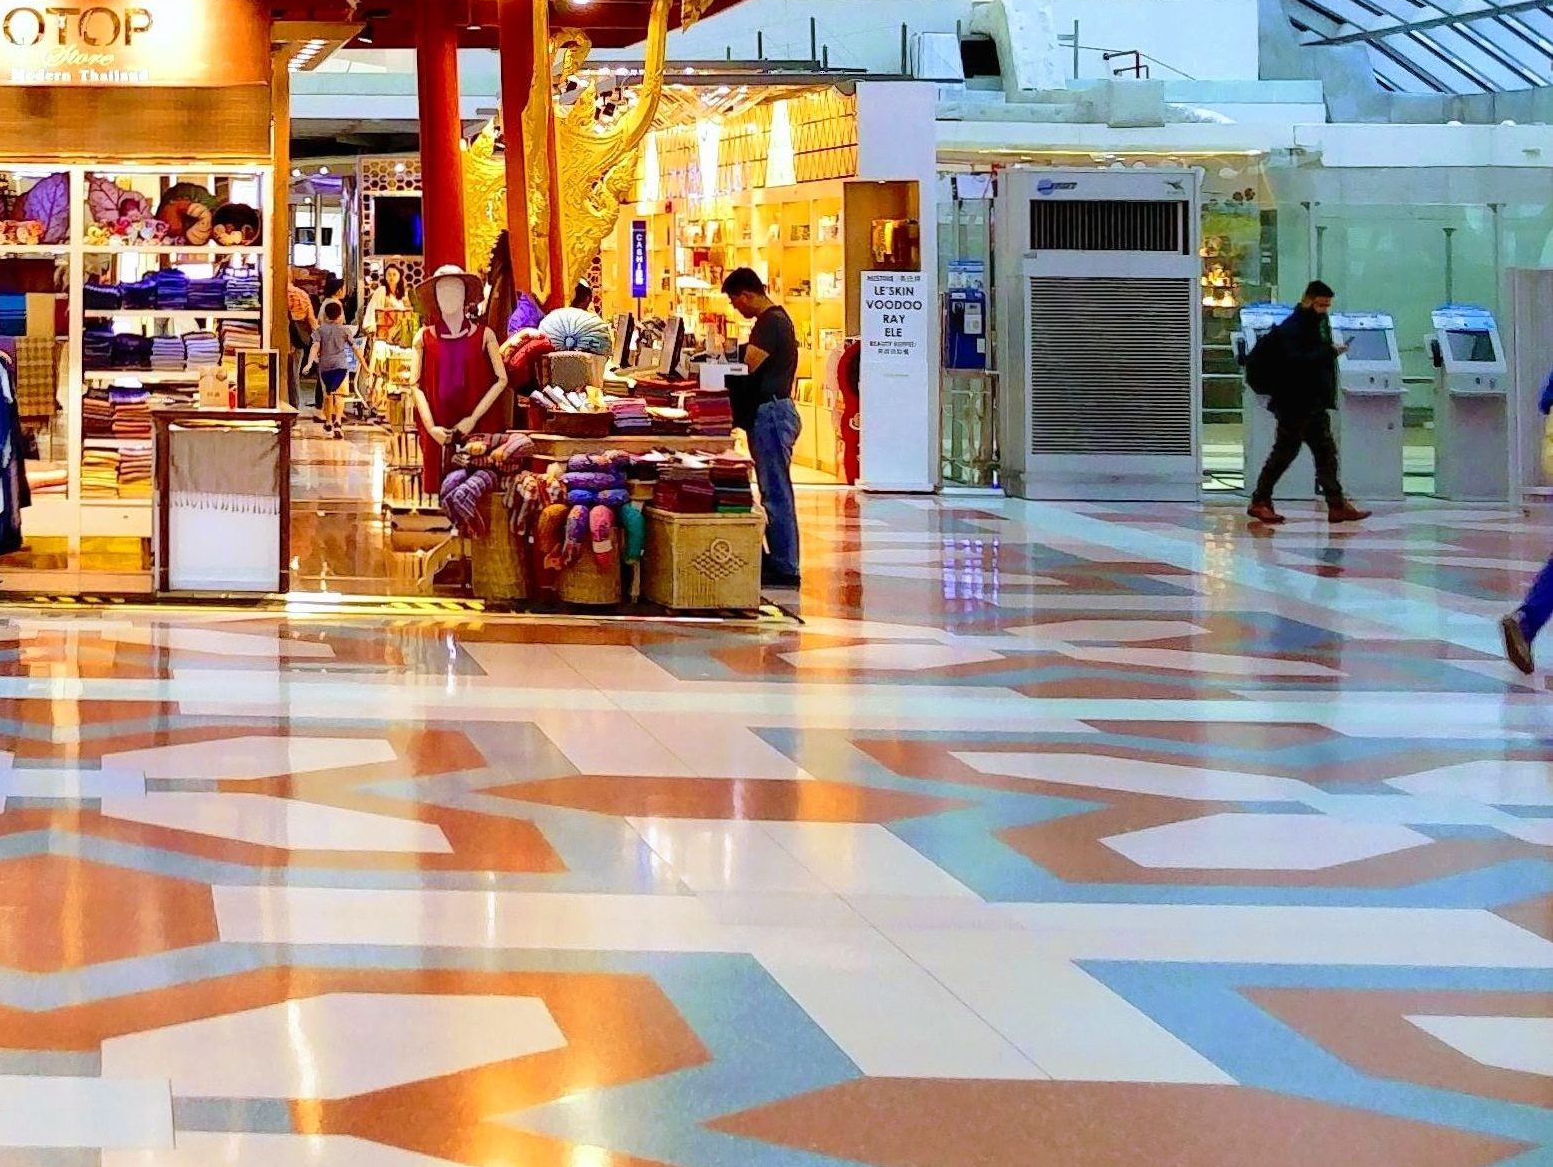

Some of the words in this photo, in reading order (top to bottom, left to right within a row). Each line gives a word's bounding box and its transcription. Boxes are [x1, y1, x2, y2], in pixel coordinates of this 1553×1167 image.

[2, 6, 154, 47] OTOP
[78, 68, 151, 82] Thailand
[866, 299, 923, 311] VOODOO
[882, 314, 906, 324] RAY
[884, 328, 903, 337] ELE
